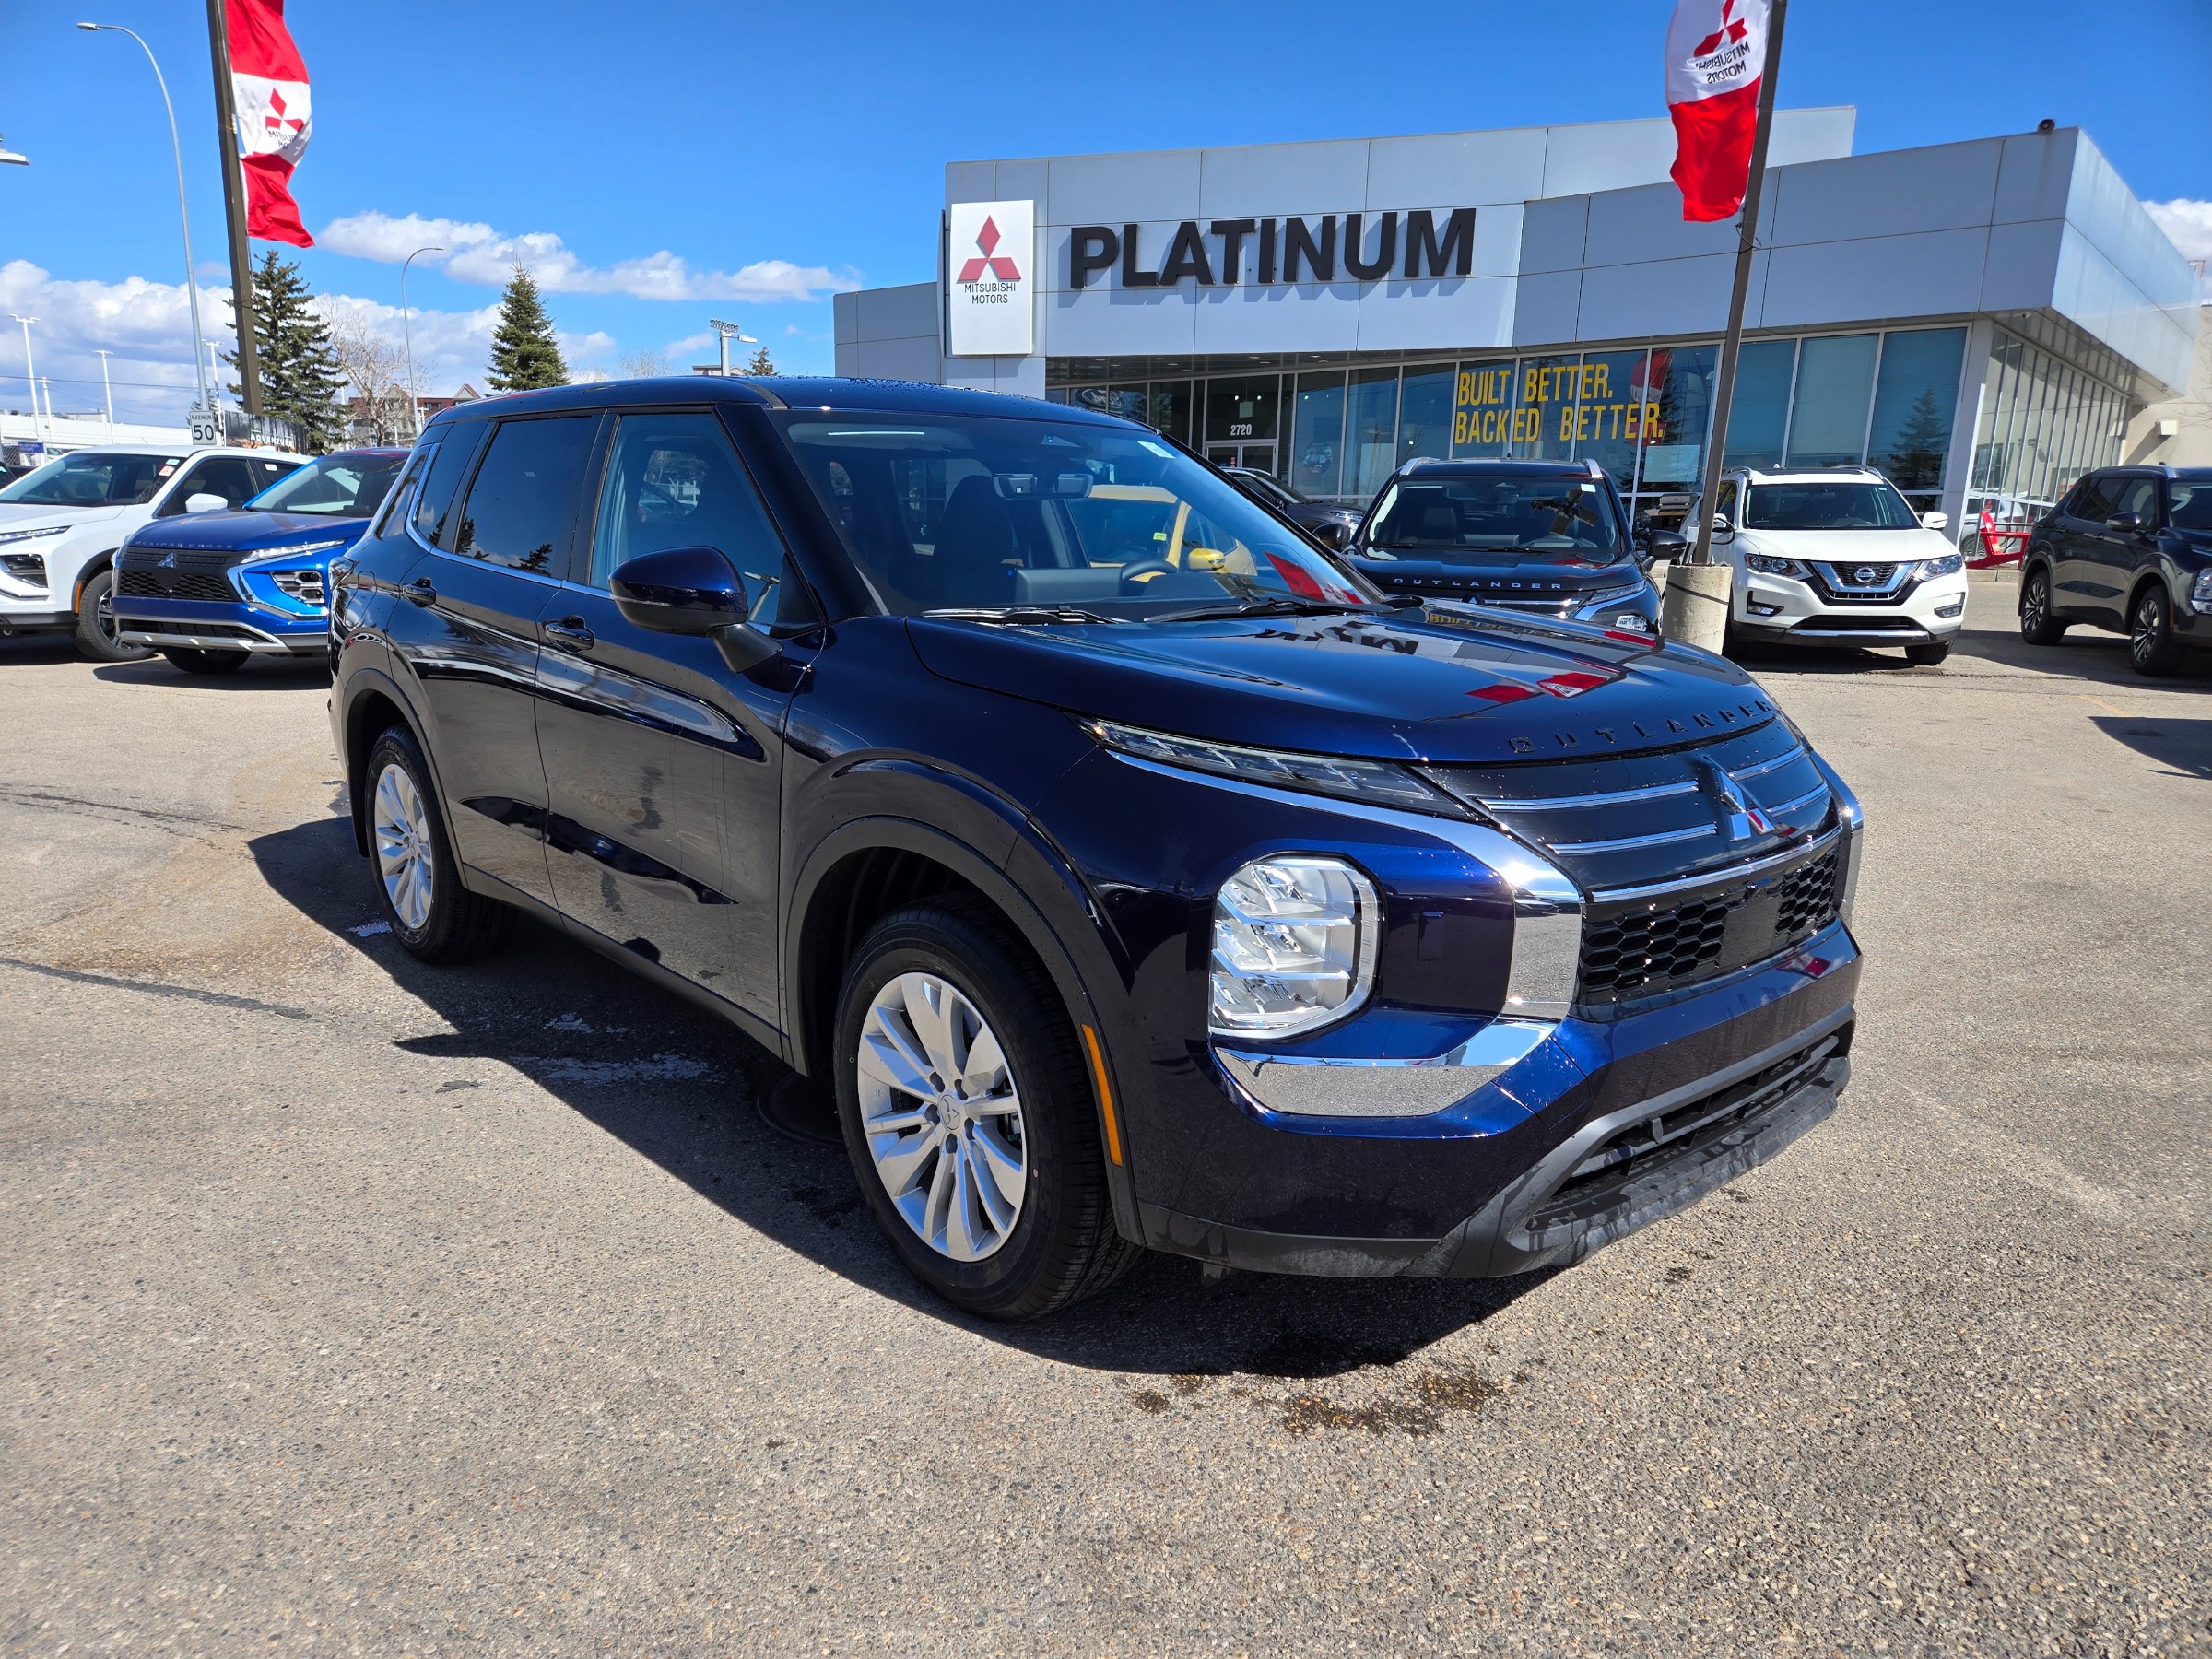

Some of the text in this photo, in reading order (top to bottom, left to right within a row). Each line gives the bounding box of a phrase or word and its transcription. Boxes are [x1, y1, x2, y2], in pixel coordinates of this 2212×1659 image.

[1070, 207, 1477, 289] PLATINUM
[964, 283, 1016, 293] MITSUBISHI
[971, 294, 1008, 304] MOTORS
[1458, 363, 1614, 406] BUILT BETTER.
[1230, 424, 1253, 436] 2720
[1454, 403, 1664, 444] BACKED BETTER.
[193, 424, 215, 441] 50
[1393, 577, 1561, 590] OUTLANDER
[1508, 699, 1773, 753] OUTLANDER
